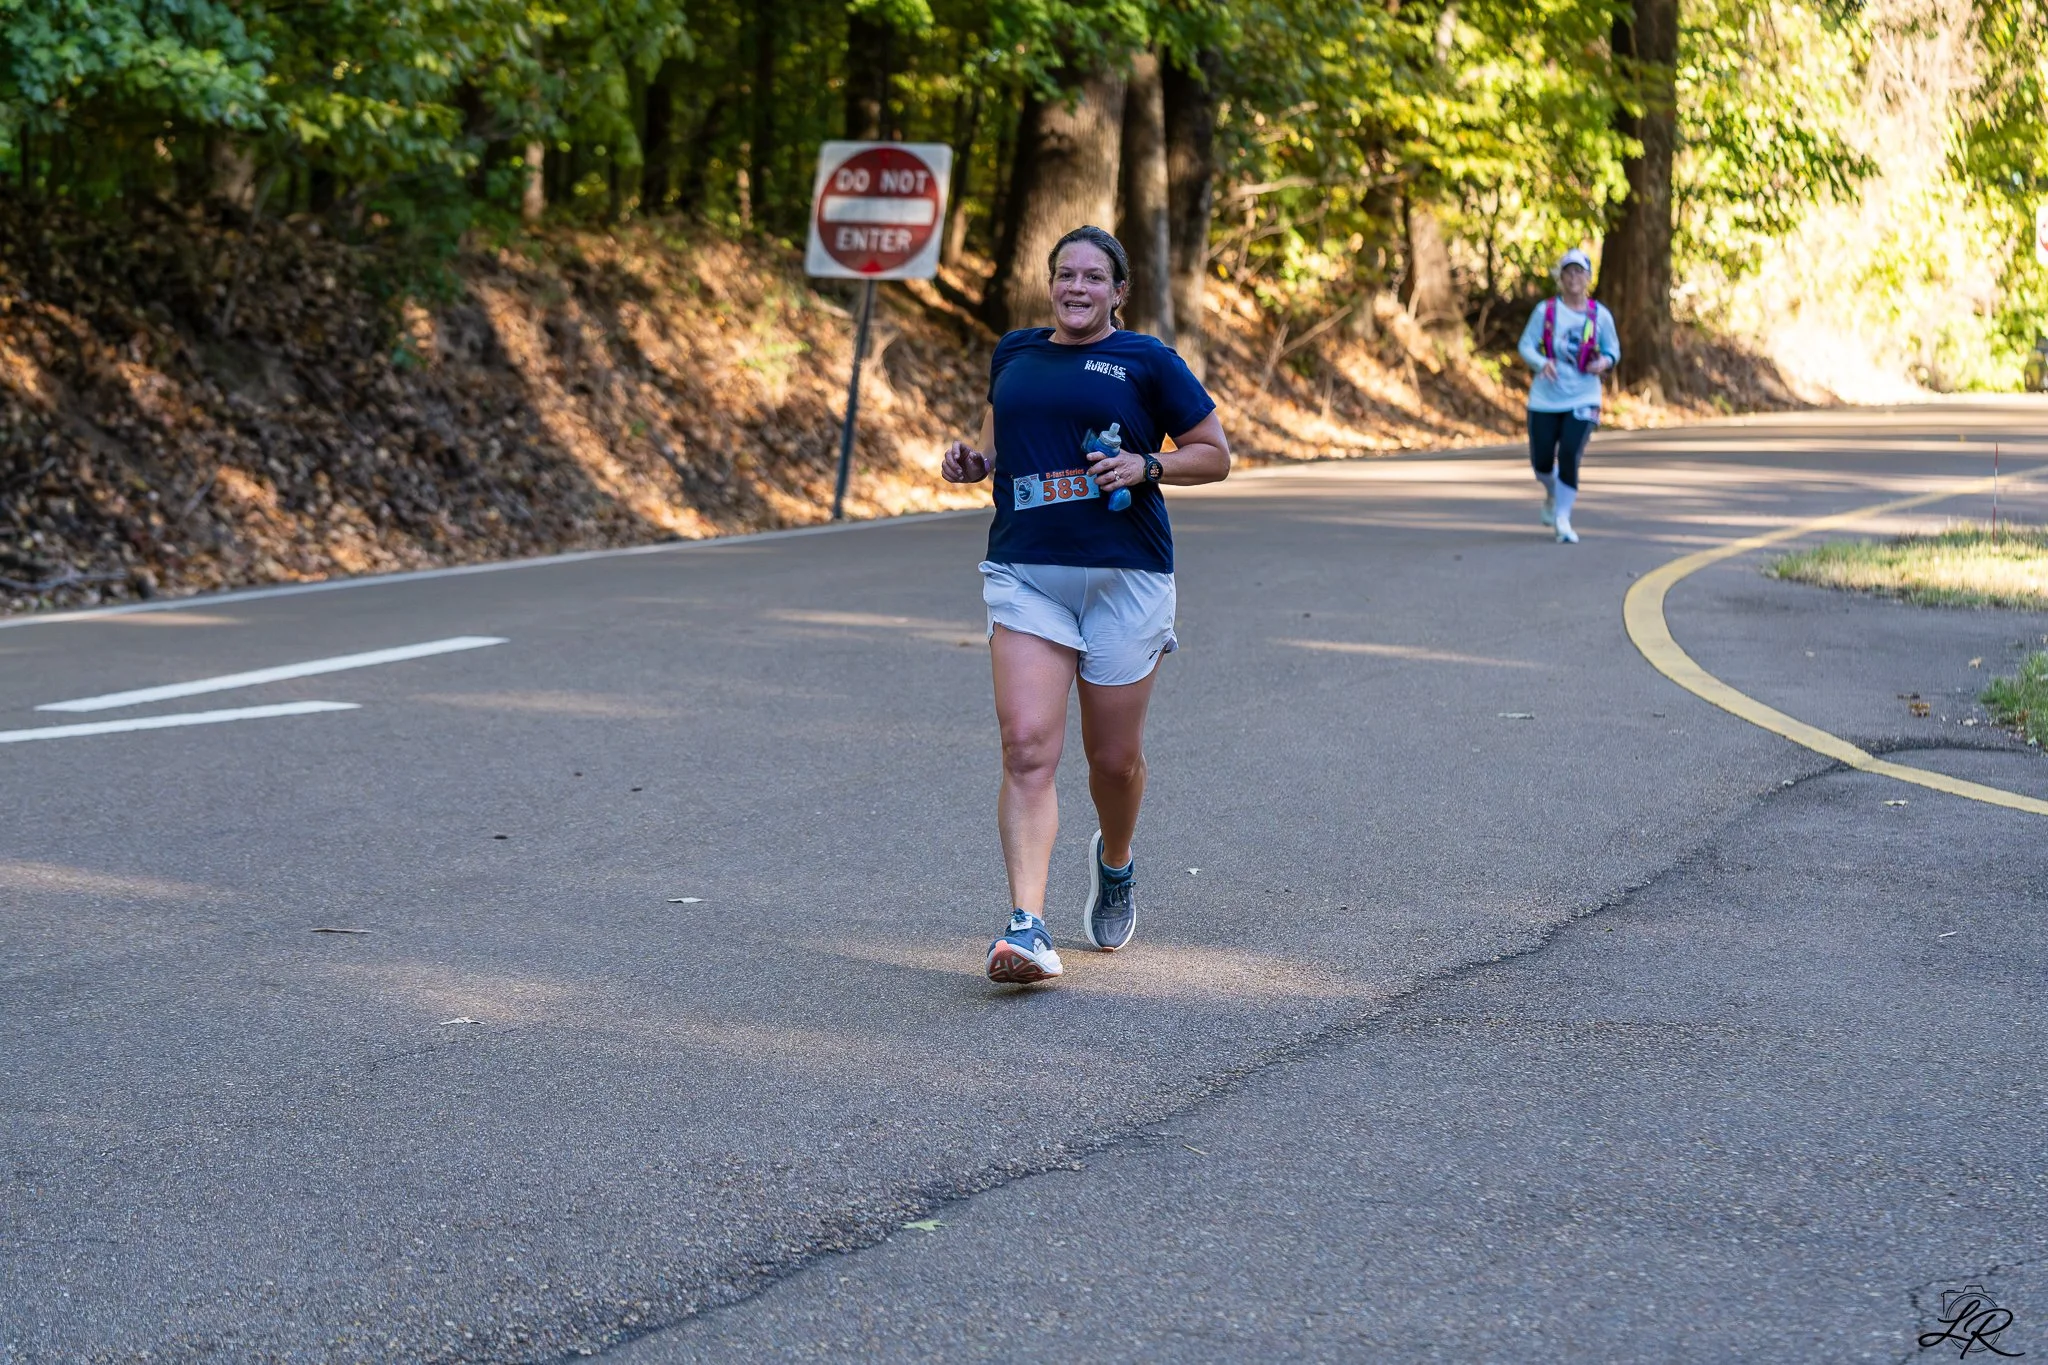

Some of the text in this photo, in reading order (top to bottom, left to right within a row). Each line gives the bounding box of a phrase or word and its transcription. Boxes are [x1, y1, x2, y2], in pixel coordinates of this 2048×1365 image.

[835, 168, 929, 193] DO NOT
[836, 228, 912, 252] ENTER
[1084, 362, 1108, 374] RUNS
[1065, 468, 1085, 477] Series
[1043, 476, 1089, 502] 583
